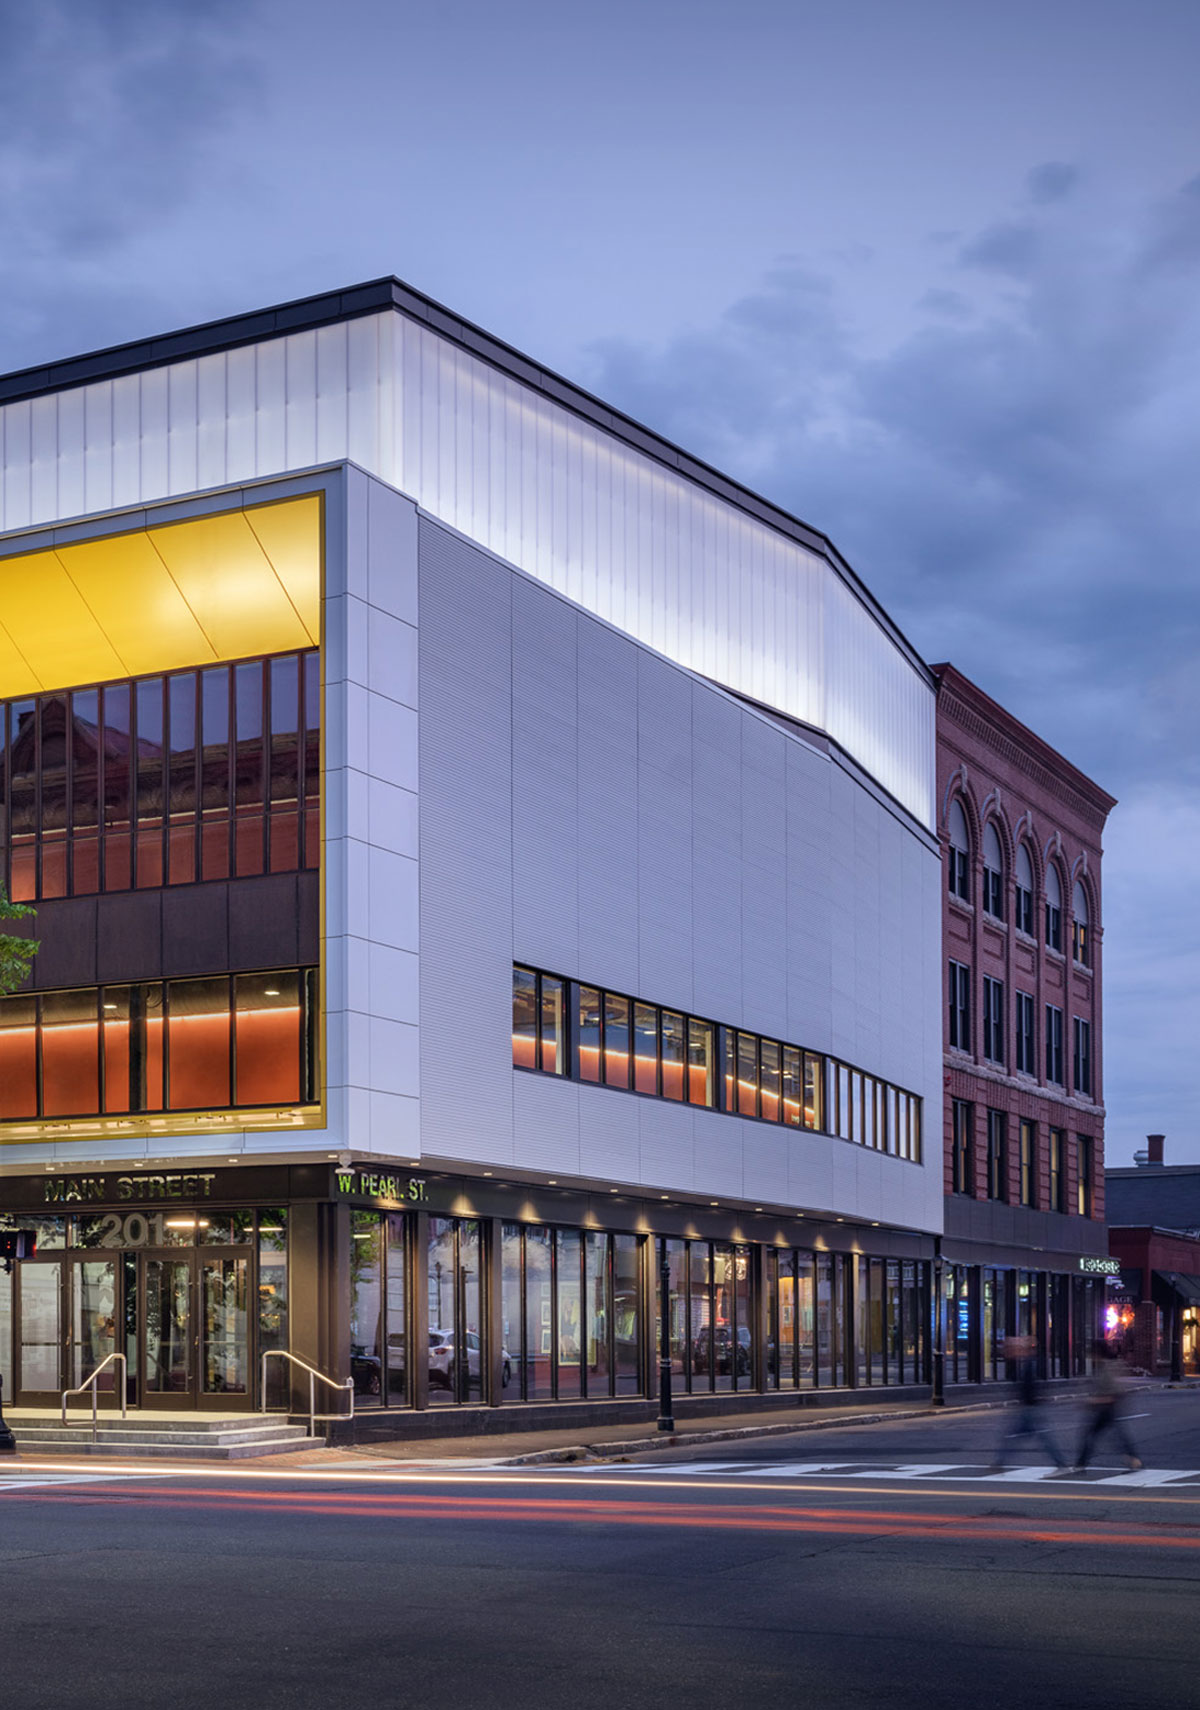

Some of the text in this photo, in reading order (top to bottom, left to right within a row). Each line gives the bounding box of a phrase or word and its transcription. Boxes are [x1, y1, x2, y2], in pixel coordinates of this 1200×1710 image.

[44, 1173, 216, 1202] MAIN STREET
[339, 1172, 429, 1201] W. PEARL ST.
[101, 1213, 164, 1246] 201
